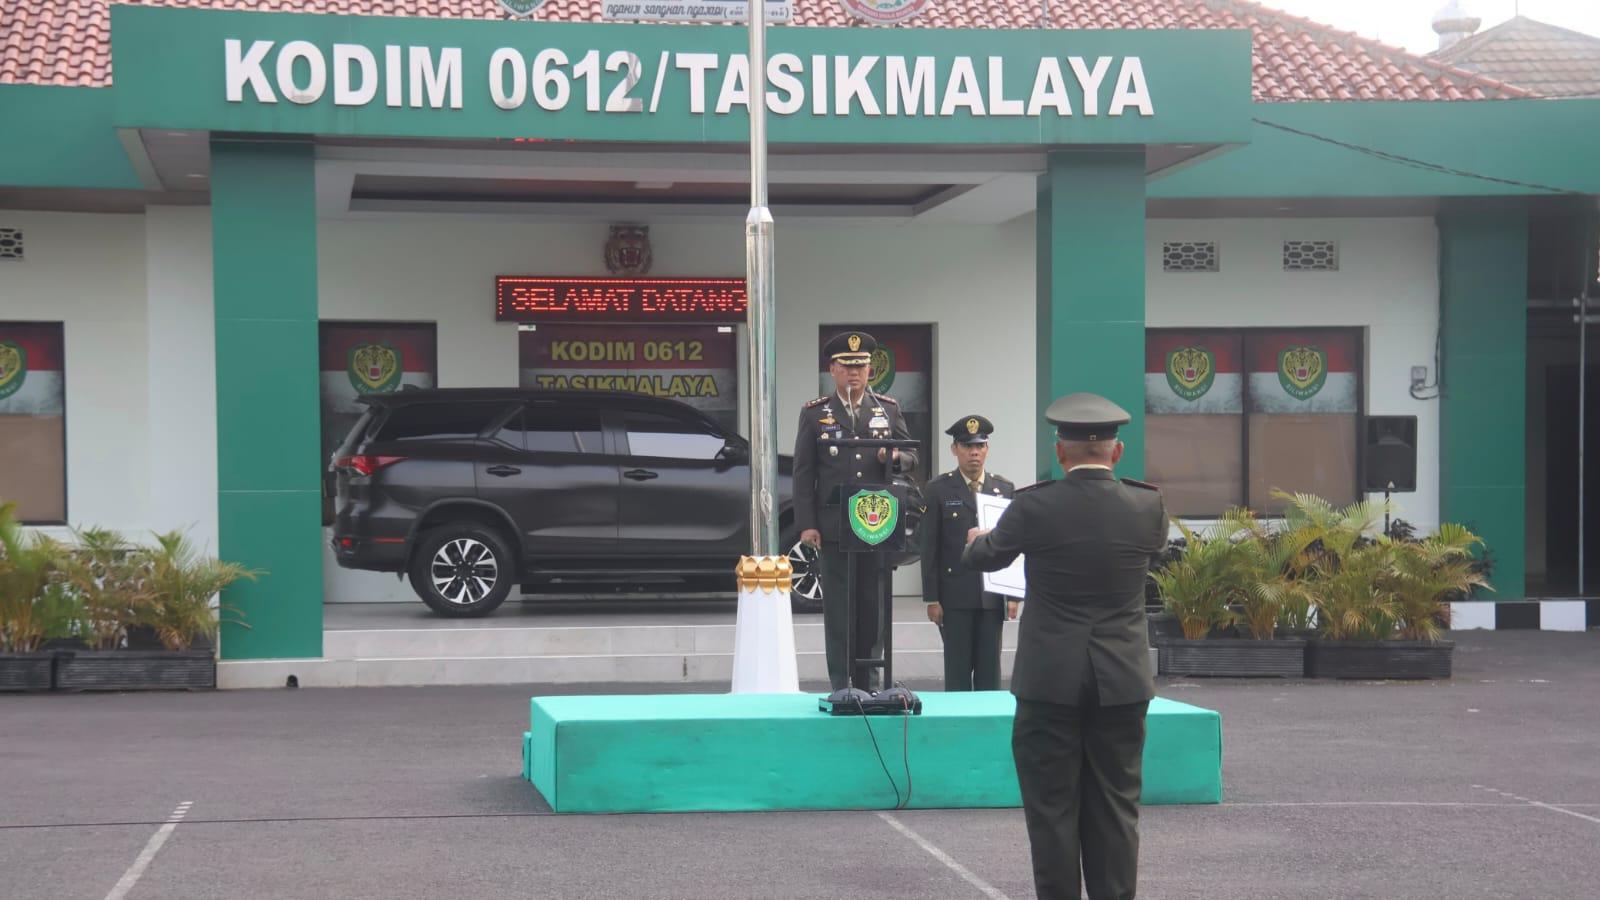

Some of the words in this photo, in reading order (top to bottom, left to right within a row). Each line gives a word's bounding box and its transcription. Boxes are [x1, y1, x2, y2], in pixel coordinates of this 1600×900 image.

[225, 39, 463, 108] KODIM
[511, 288, 635, 311] SELAMAT
[642, 289, 747, 312] DATANG
[551, 341, 635, 361] KODIM
[643, 341, 703, 361] 0612
[538, 375, 718, 396] TASIKMALAYA
